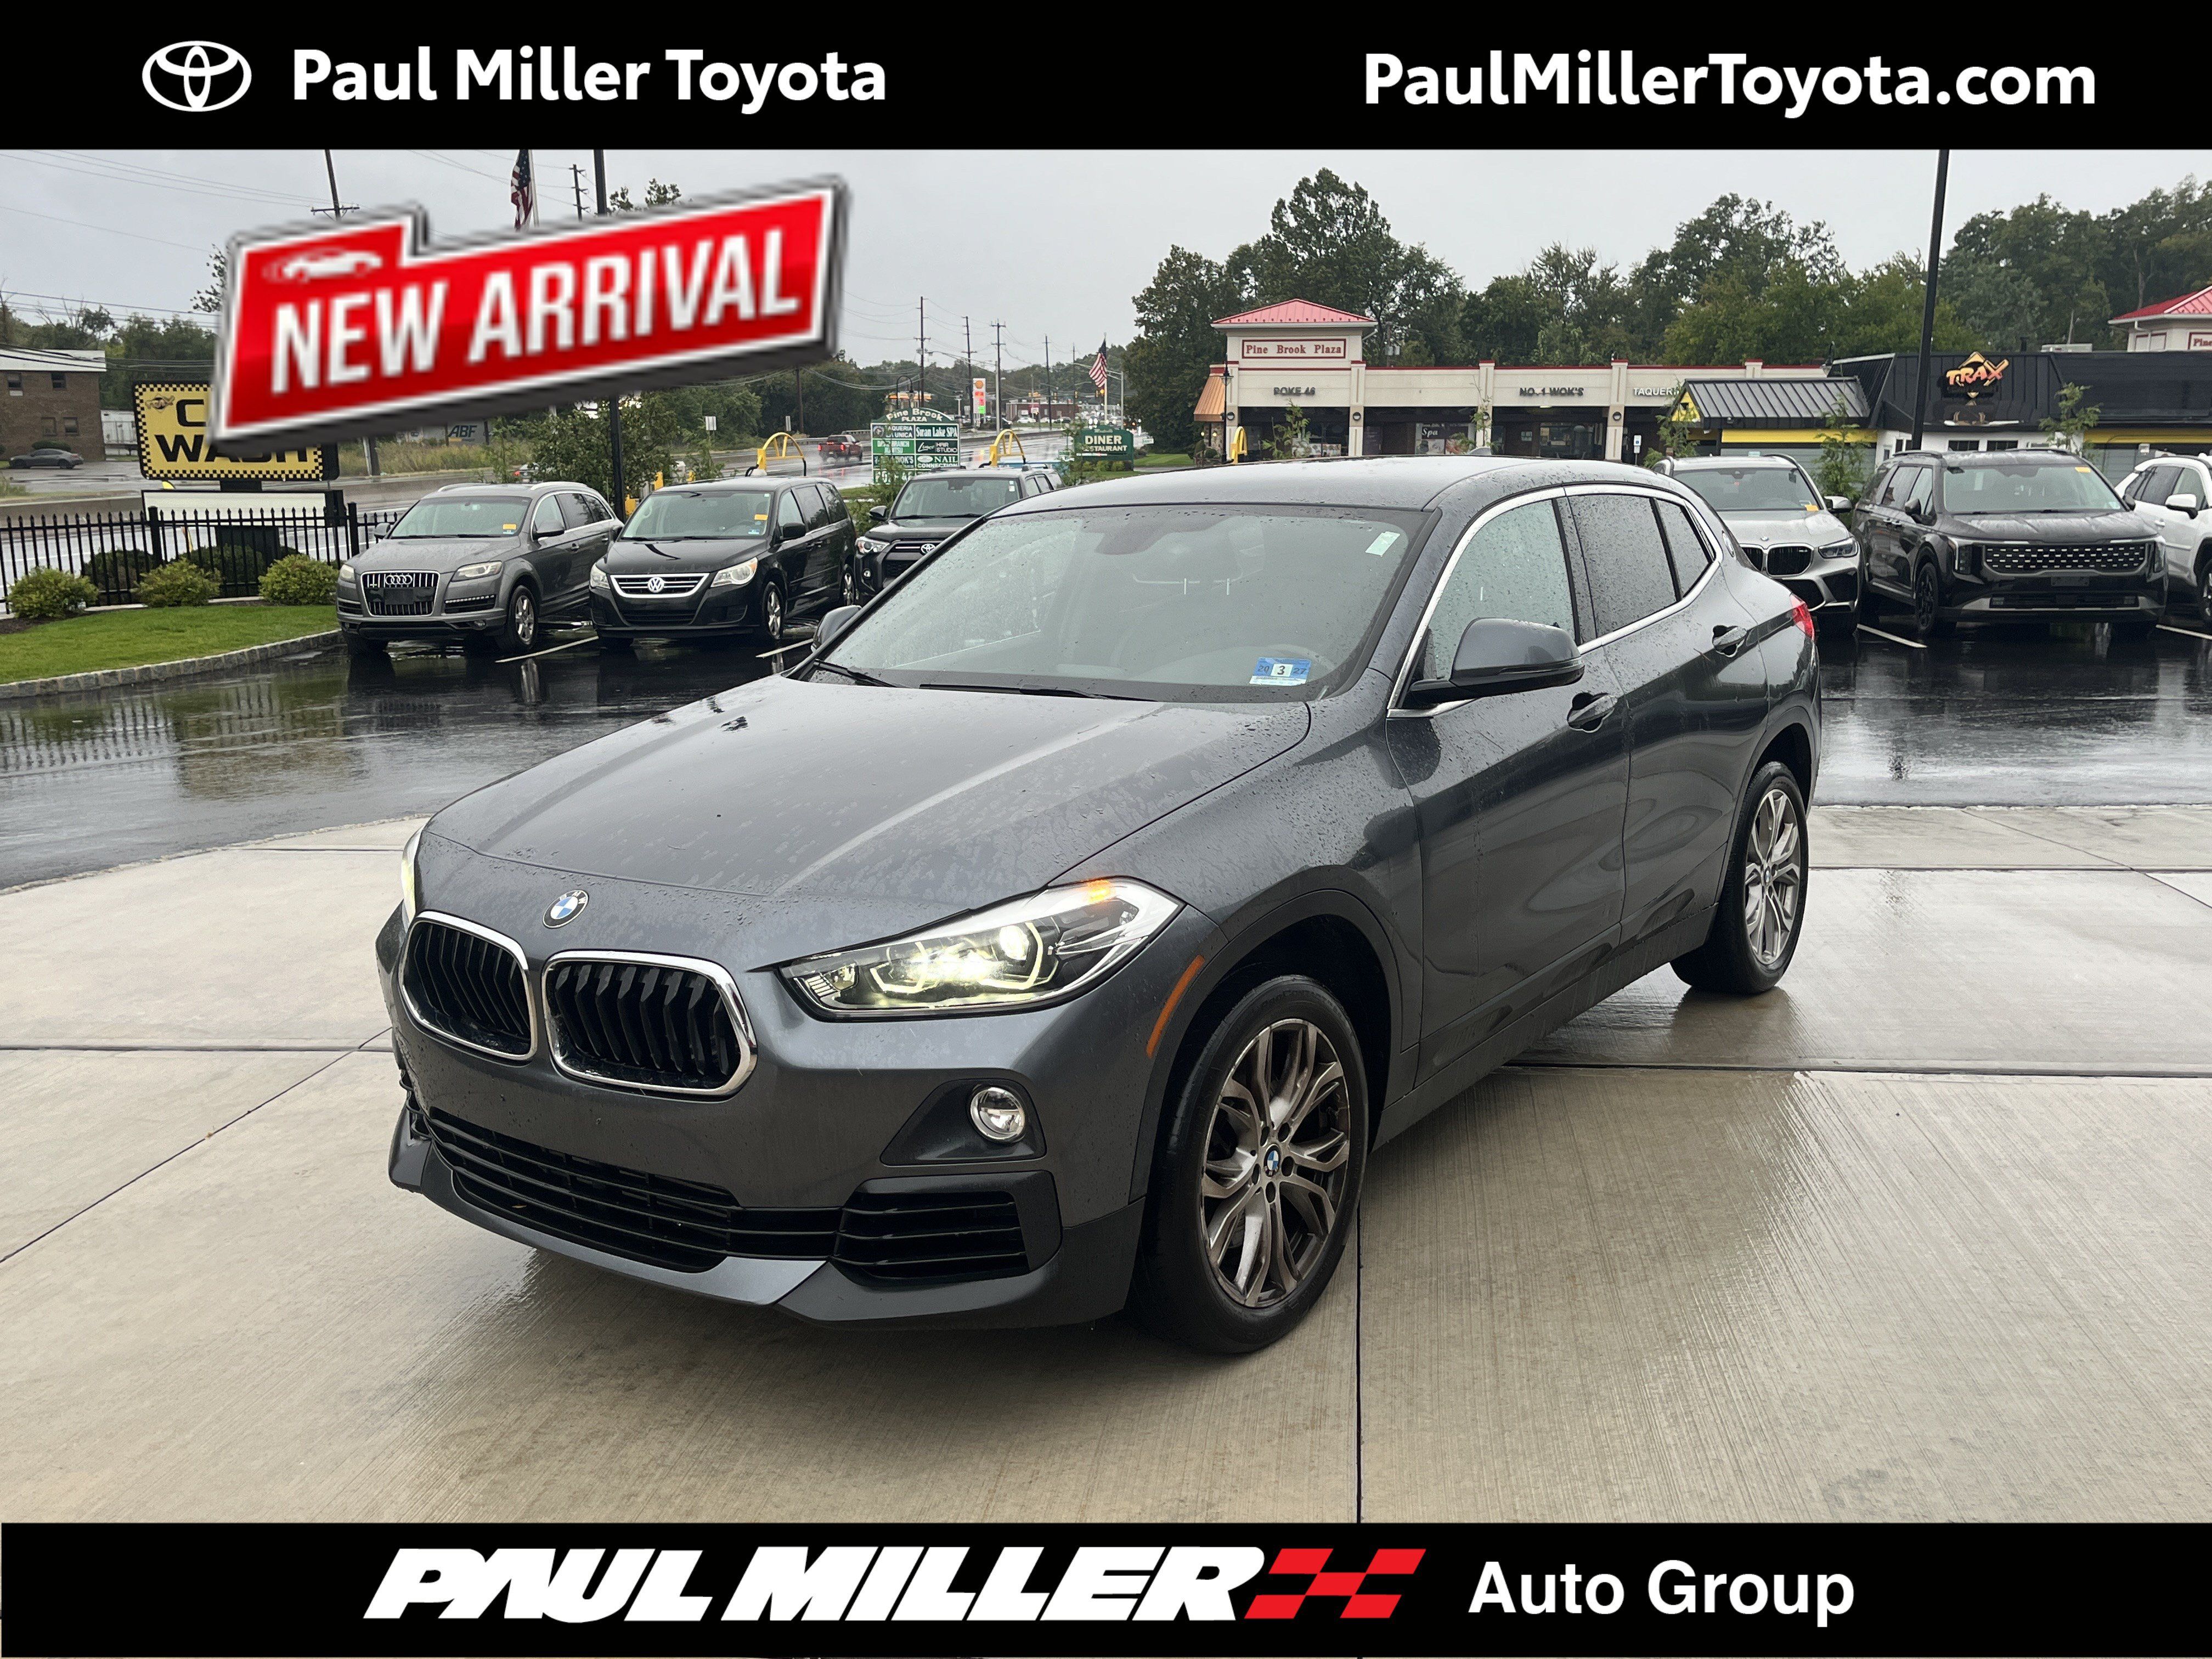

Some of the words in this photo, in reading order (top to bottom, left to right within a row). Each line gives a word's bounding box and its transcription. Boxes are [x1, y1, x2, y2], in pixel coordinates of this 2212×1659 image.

[1246, 345, 1268, 354] Pine
[1277, 345, 1306, 354] Brook
[1314, 345, 1341, 354] Plaza
[1946, 359, 2008, 385] TRAX
[1549, 387, 1584, 396] WOK'S
[886, 410, 909, 421] Pine
[912, 408, 943, 421] Brook
[448, 425, 477, 437] ABF
[933, 427, 945, 437] Lake
[946, 427, 958, 437] SPA
[1422, 428, 1438, 438] Spa
[1085, 435, 1122, 445] DINER
[1257, 664, 1270, 674] 20
[1277, 665, 1285, 675] 3
